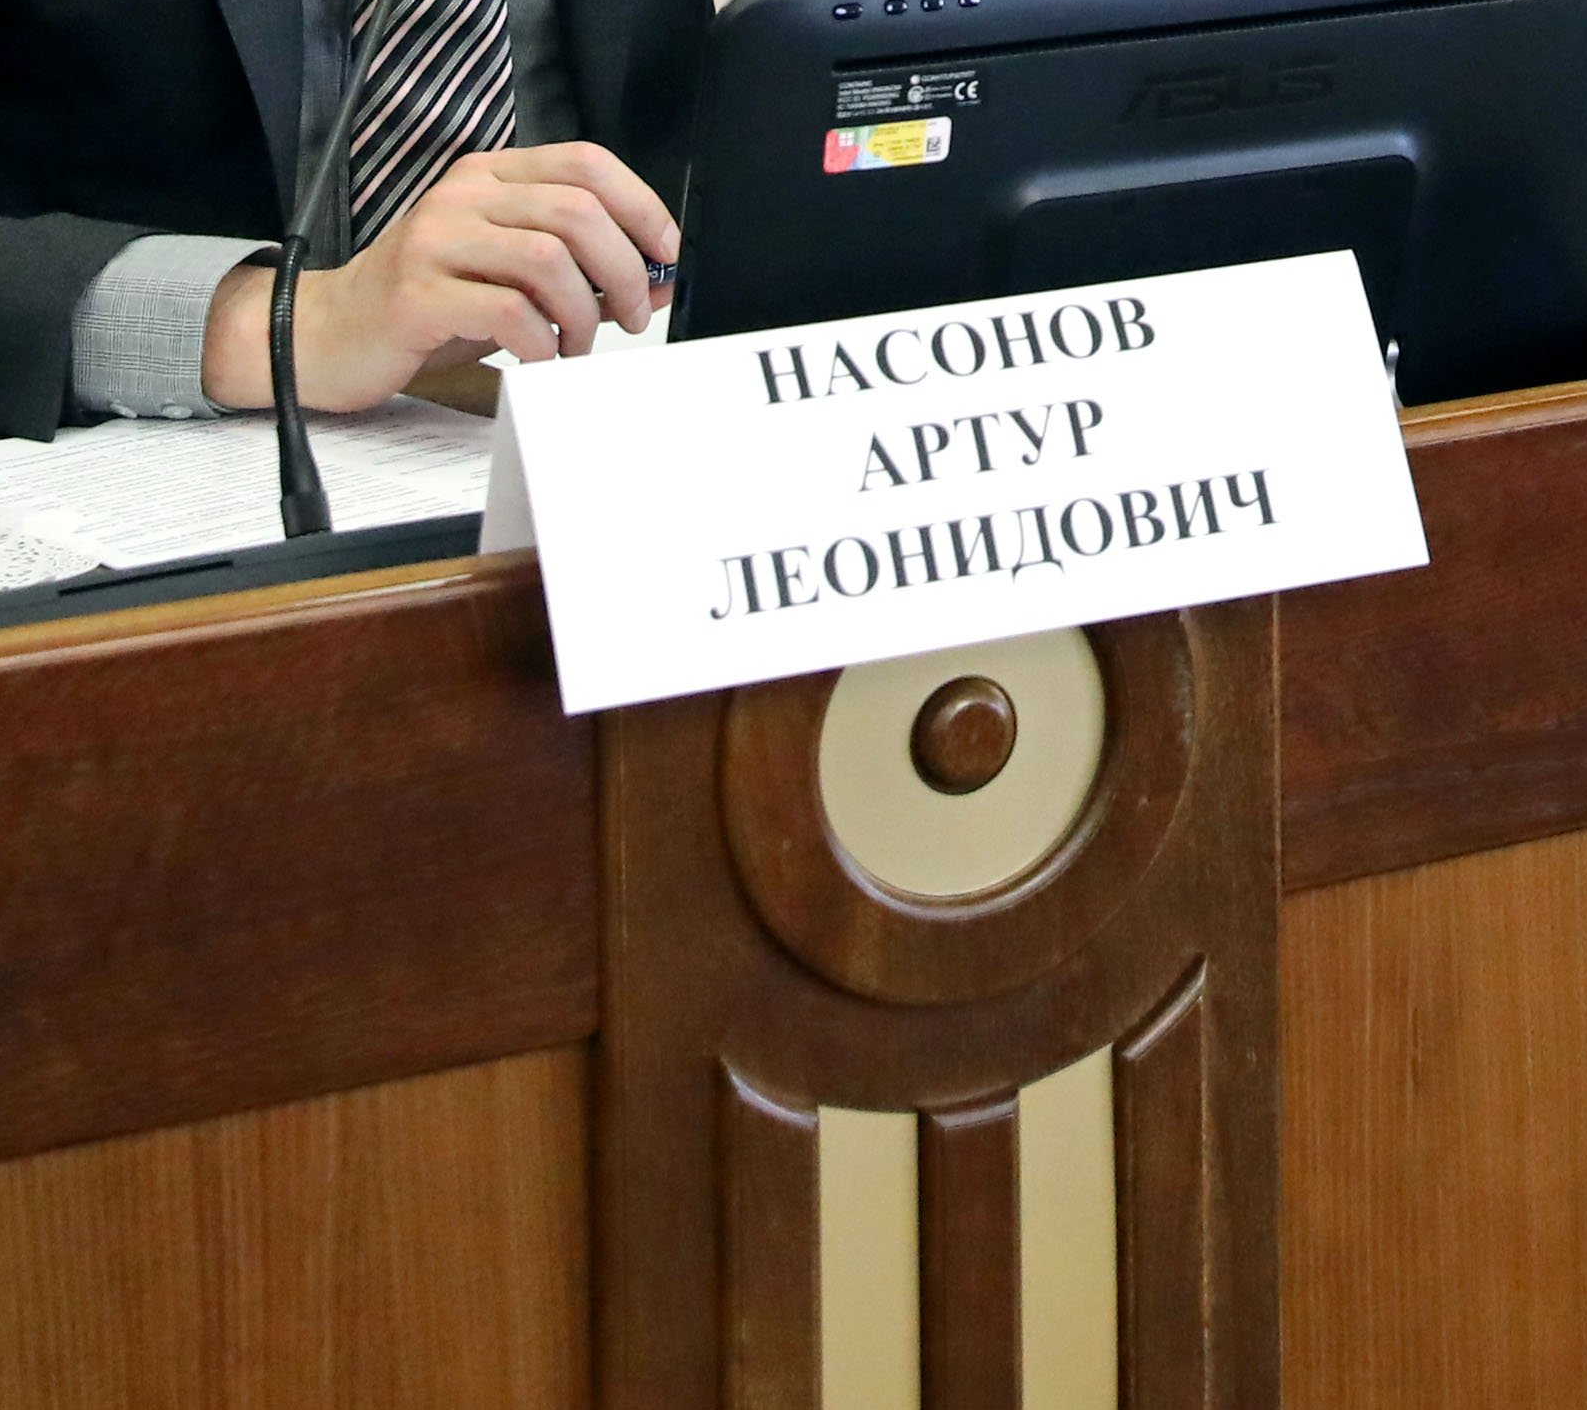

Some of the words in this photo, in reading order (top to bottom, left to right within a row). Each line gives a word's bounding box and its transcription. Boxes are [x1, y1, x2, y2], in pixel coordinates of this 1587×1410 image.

[954, 80, 979, 101] CE
[1116, 53, 1338, 125] ASUS
[756, 296, 1157, 406] НАСОНОВ
[856, 397, 1105, 492] АРТУР
[709, 468, 1280, 621] ЛЕОНИДОВИЧ
